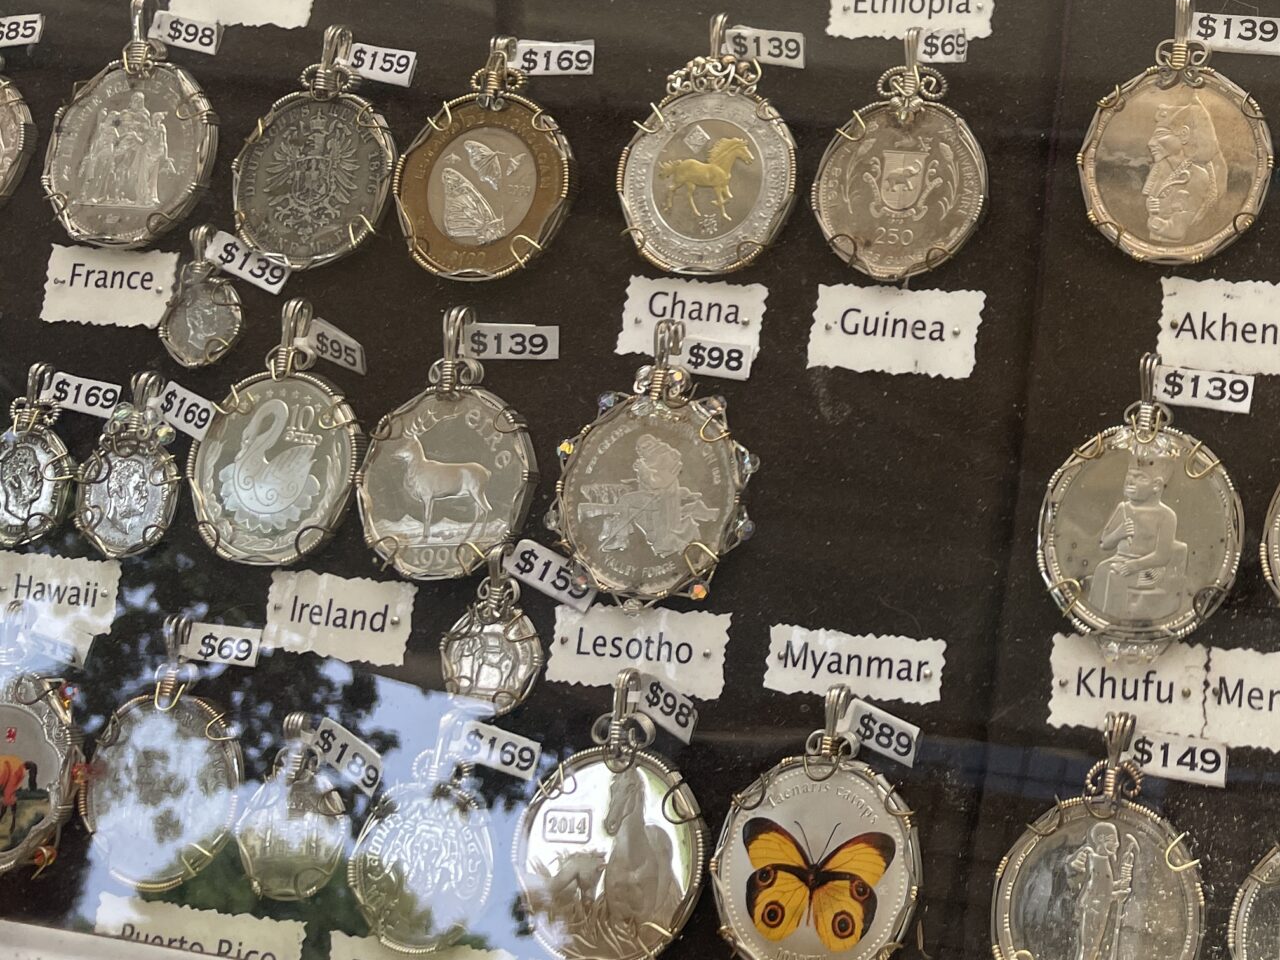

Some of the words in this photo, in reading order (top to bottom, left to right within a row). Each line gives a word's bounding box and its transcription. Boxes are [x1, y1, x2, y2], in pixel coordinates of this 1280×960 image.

[167, 19, 216, 47] $98
[731, 32, 801, 60] $139
[1196, 15, 1279, 43] $139
[350, 46, 411, 74] $159
[520, 48, 593, 73] $169
[69, 262, 154, 292] France
[218, 241, 286, 286] $139
[647, 290, 740, 325] Ghana
[840, 307, 945, 338] Guinea
[316, 331, 357, 368] $95
[470, 330, 549, 356] $139
[688, 343, 744, 372] $98
[53, 378, 119, 410] $169
[1163, 370, 1251, 403] $139
[160, 390, 211, 431] $169
[14, 573, 98, 608] Hawaii
[291, 596, 389, 633] Ireland
[198, 633, 253, 659] $69
[576, 627, 693, 665] Lesotho
[784, 640, 929, 682] Myanmar
[1076, 666, 1175, 705] Khufu
[645, 682, 695, 729] $98
[465, 729, 536, 772] $169
[858, 712, 914, 758] $89
[317, 728, 381, 789] $189
[1133, 736, 1222, 775] $149
[547, 816, 587, 837] 2014
